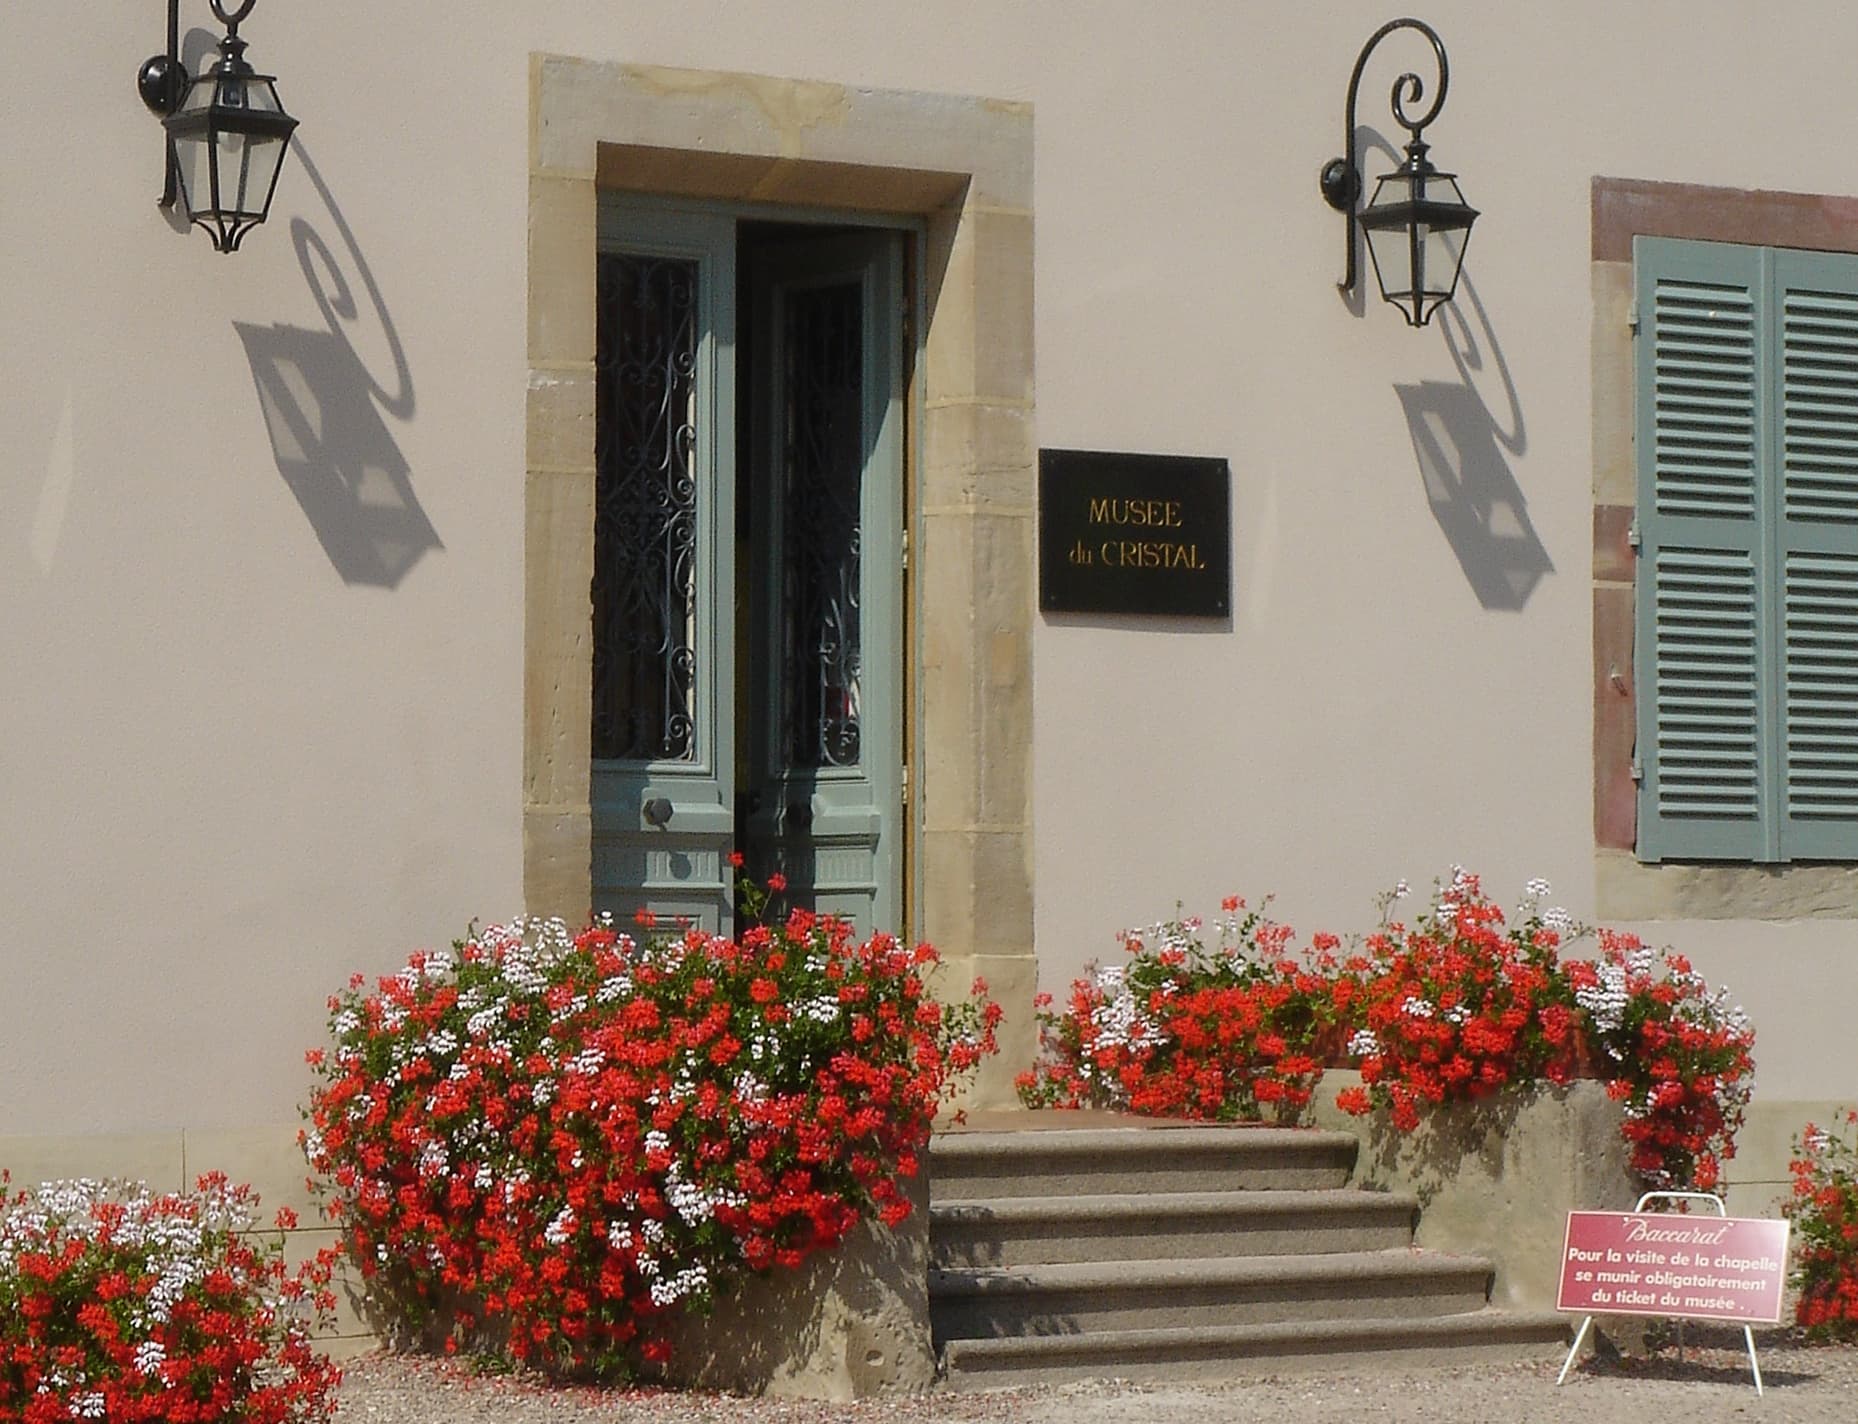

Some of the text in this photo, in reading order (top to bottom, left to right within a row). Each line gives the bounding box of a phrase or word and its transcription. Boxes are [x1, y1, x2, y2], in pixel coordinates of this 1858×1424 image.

[1089, 498, 1183, 527] MUSEE
[1069, 540, 1206, 569] du CRISTAL
[1568, 1248, 1777, 1274] Pour la visite de la chapelle
[1575, 1270, 1766, 1292] se munir obligatoirement
[1592, 1289, 1611, 1303] du
[1616, 1291, 1656, 1305] ticket
[1660, 1291, 1680, 1306] du
